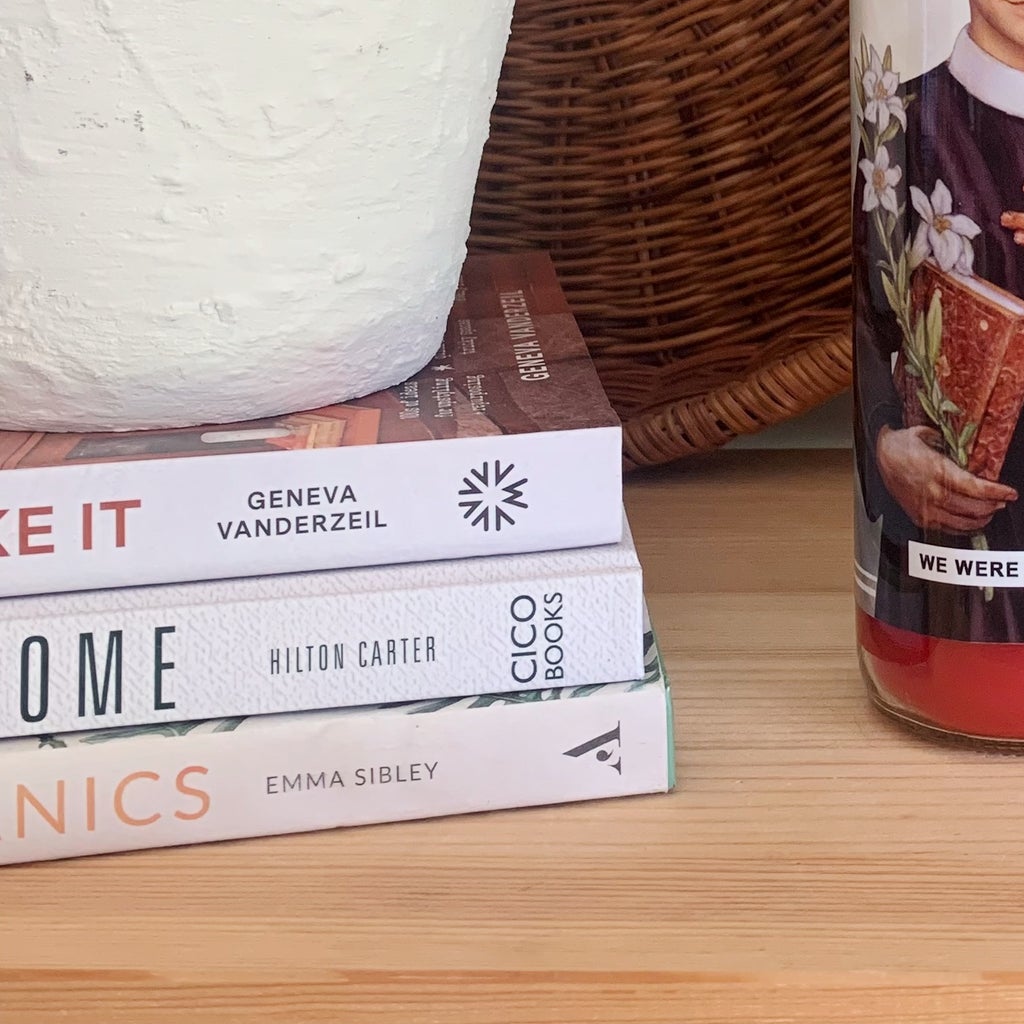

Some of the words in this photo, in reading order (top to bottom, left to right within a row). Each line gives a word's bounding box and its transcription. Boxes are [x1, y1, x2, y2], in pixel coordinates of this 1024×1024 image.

[499, 289, 536, 340] VANDERZEIL
[513, 340, 550, 381] GENEVA
[431, 377, 456, 407] upstyling
[247, 484, 357, 510] GENEVA
[0, 505, 55, 557] E
[82, 499, 142, 551] IT
[216, 510, 388, 541] VANDERZEIL
[919, 552, 948, 574] WE
[955, 558, 1019, 578] WERE
[270, 643, 345, 675] HILTON
[358, 635, 437, 668] CARTER
[510, 594, 537, 684] CICO
[543, 592, 563, 680] BOOKS
[19, 625, 176, 724] OME
[266, 770, 345, 795] EMMA
[354, 762, 439, 787] SIBLEY
[16, 765, 211, 839] NICS
